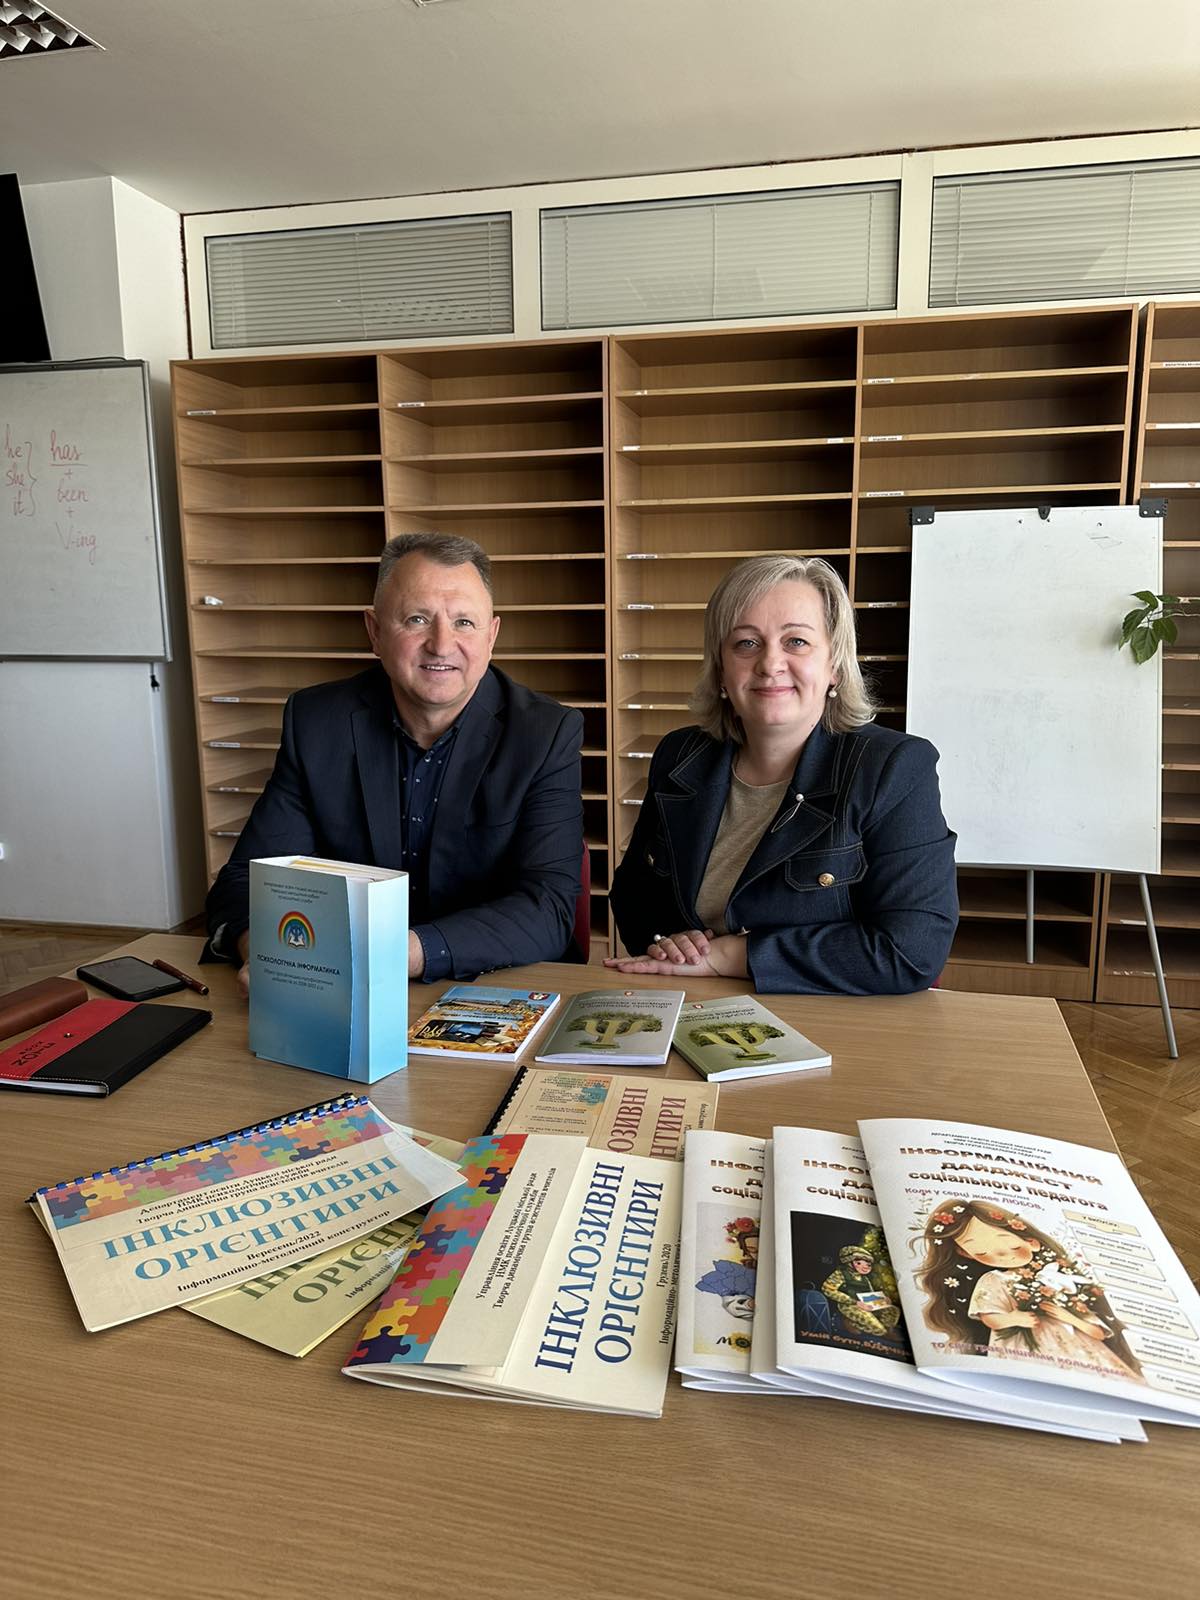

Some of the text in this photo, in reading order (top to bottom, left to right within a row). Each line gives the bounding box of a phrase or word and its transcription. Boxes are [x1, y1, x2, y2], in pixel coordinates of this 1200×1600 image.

[4, 424, 23, 459] he
[50, 429, 83, 461] has
[5, 462, 25, 487] she
[57, 479, 88, 503] been
[13, 489, 25, 516] it
[140, 1155, 337, 1215] Департамент освіти Луцької міської ради
[205, 1177, 275, 1200] психологічної
[275, 1168, 310, 1181] служби
[899, 1147, 1103, 1186] ІНФОРМАЦІЙНИЙ
[941, 1162, 1072, 1190] ДАЙДЖЕСТ
[103, 1156, 398, 1260] ІНКЛЮЗИВНІ
[138, 1160, 349, 1224] Творча динамічна група асистентів вчителів
[908, 1171, 1022, 1193] соціального
[1026, 1186, 1109, 1211] педагога
[134, 1180, 401, 1280] ОРІЄНТИРИ
[327, 1209, 390, 1241] конструктор
[475, 1172, 538, 1299] Управління освіти Луцької міської ради
[492, 1167, 557, 1309] Творча динамічна група асистентів вчителів
[505, 1213, 530, 1258] психологічної
[524, 1189, 539, 1213] служби
[246, 1230, 321, 1261] Вересень/2022
[535, 1162, 625, 1374] ІНКЛЮЗИВНІ
[594, 1179, 664, 1364] ОРІЄНТИРИ
